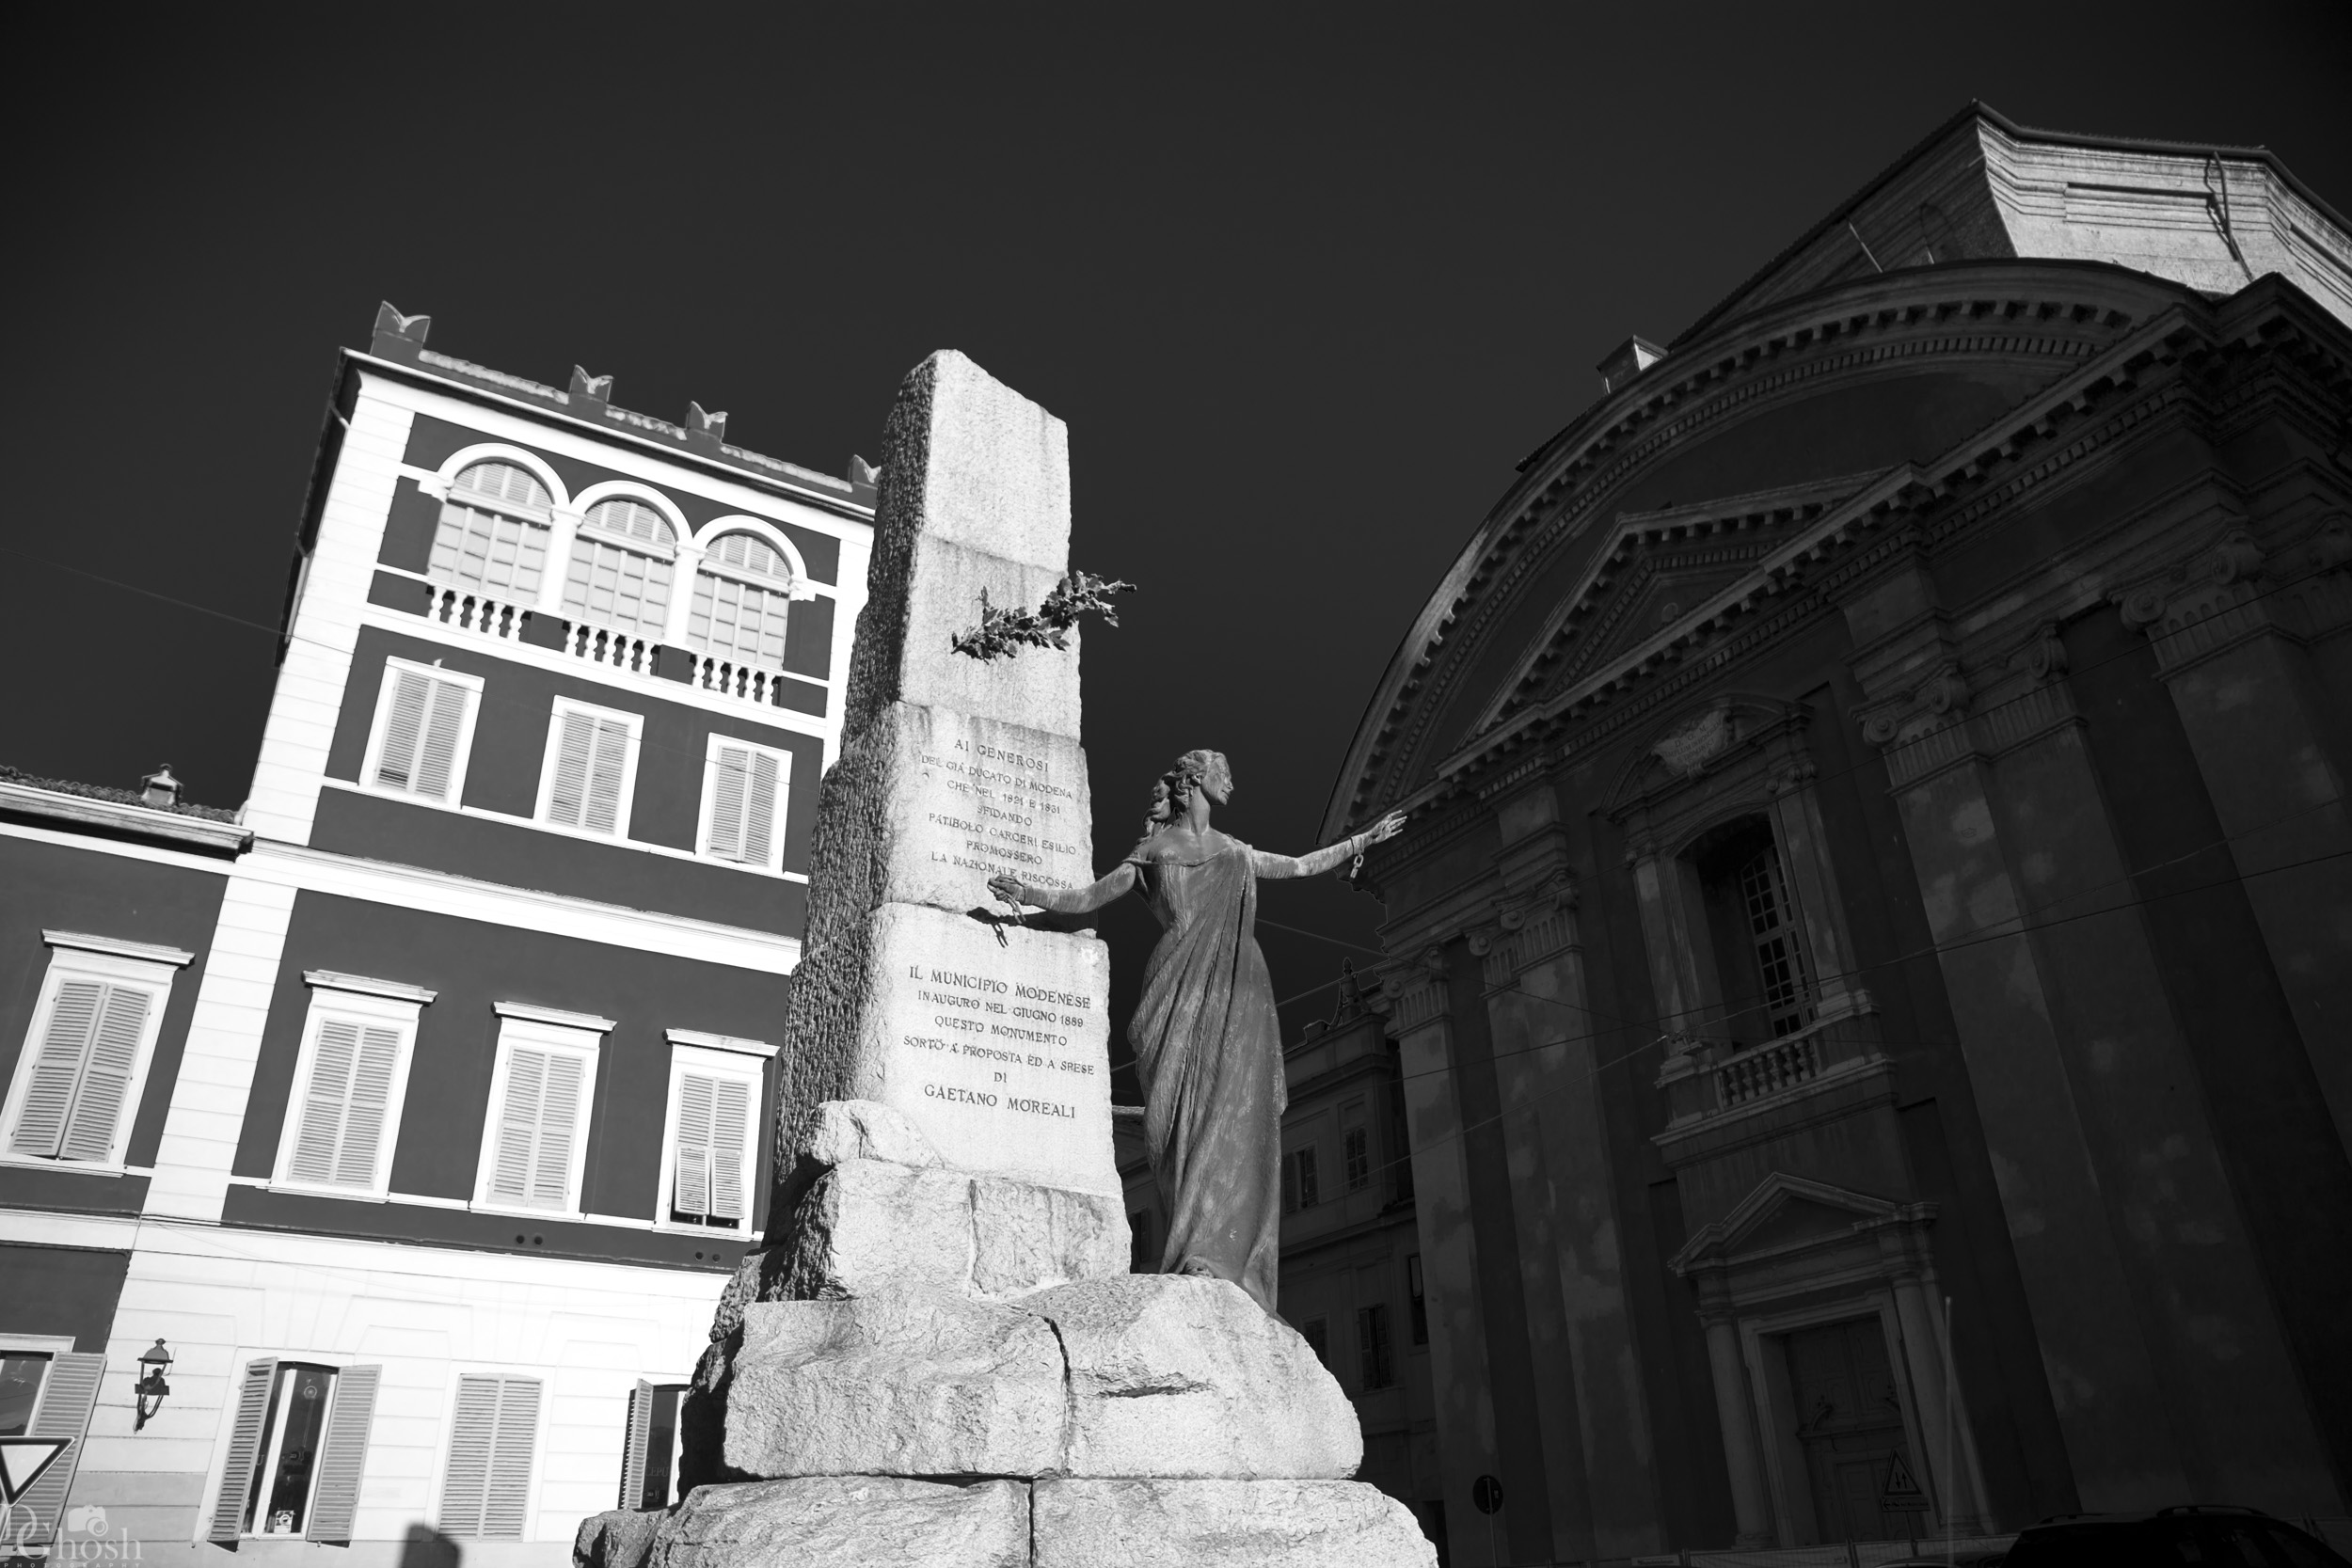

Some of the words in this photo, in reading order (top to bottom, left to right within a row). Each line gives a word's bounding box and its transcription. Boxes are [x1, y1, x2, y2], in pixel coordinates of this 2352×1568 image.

[954, 738, 969, 752] AI
[977, 744, 1049, 772] GENEROSI
[921, 754, 942, 767] DEL
[968, 766, 1011, 784] DUCATO
[1015, 777, 1026, 788] DI
[1029, 781, 1073, 800] MODENA
[946, 780, 969, 793] CHE
[974, 785, 995, 800] NEL
[1003, 793, 1025, 806] 1821
[1029, 799, 1036, 809] E
[977, 805, 1033, 827] SFIDANDO
[929, 813, 984, 833] PATIBOLO
[989, 827, 1038, 847] CARCERI
[1041, 839, 1076, 855] ESILIO
[966, 840, 1042, 865] PROMOSSERO
[931, 851, 947, 863] LA
[952, 855, 1017, 878] NAZIONALE
[1021, 870, 1073, 890] RISCOSSA
[909, 964, 923, 980] IL
[930, 969, 1008, 994] MUNICIPIO
[1014, 984, 1091, 1009] MODENESE
[934, 1015, 984, 1033] QUESTO
[991, 1024, 1068, 1046] MONUMENTO
[985, 1002, 1008, 1016] NEL
[1012, 1006, 1057, 1023] GIUGNO
[1060, 1014, 1084, 1027] 1889
[903, 1036, 944, 1051] SORTO
[962, 1044, 1023, 1064] PROPOSTA
[1027, 1054, 1043, 1068] ED
[1047, 1059, 1056, 1069] A
[1060, 1060, 1095, 1075] SPESE
[993, 1071, 1007, 1084] DI
[924, 1084, 997, 1108] GAETANO
[1007, 1096, 1076, 1119] MOREALI
